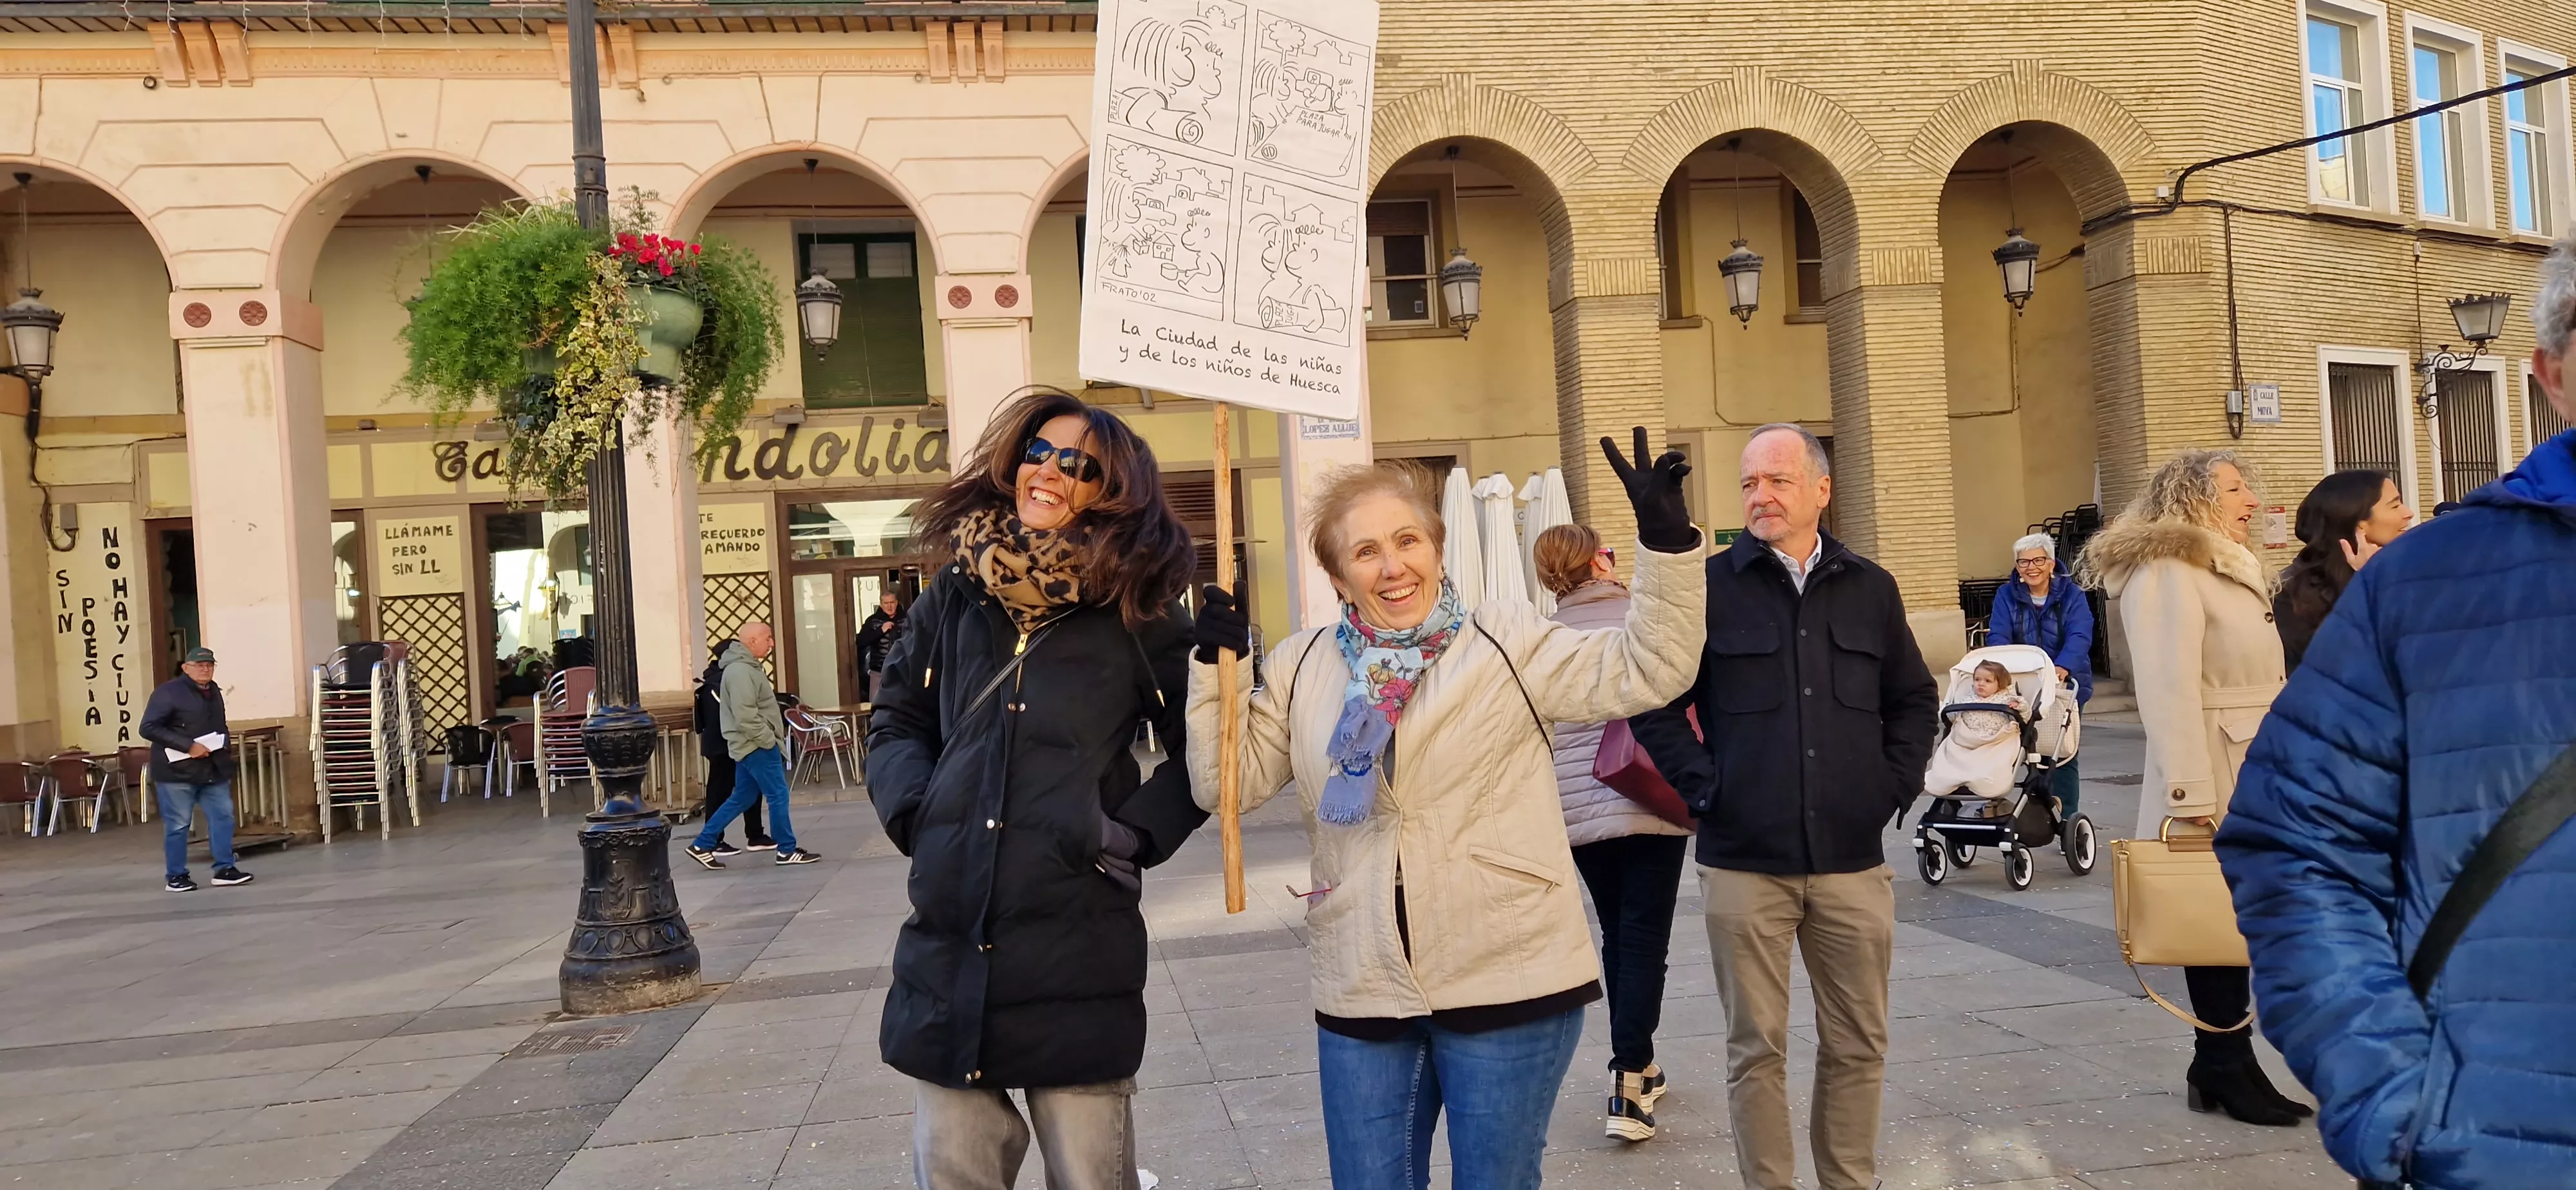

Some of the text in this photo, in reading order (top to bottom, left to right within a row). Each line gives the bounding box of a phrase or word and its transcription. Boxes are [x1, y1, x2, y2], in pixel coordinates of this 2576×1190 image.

[1110, 95, 1120, 120] PLAZA
[1300, 110, 1323, 122] PLAZA
[1296, 117, 1340, 138] PARA JUGAR
[1121, 319, 1341, 374] La Ciudad de las niñas
[1119, 343, 1341, 395] y de los niños de Huesca
[698, 513, 713, 524] TE
[385, 523, 453, 540] LLÁMAME
[701, 528, 765, 540] RECUERDO
[392, 545, 427, 557] PERO
[392, 559, 440, 575] SIN LL
[55, 569, 73, 634] SIN
[102, 526, 131, 748] NO HAY CIUDA
